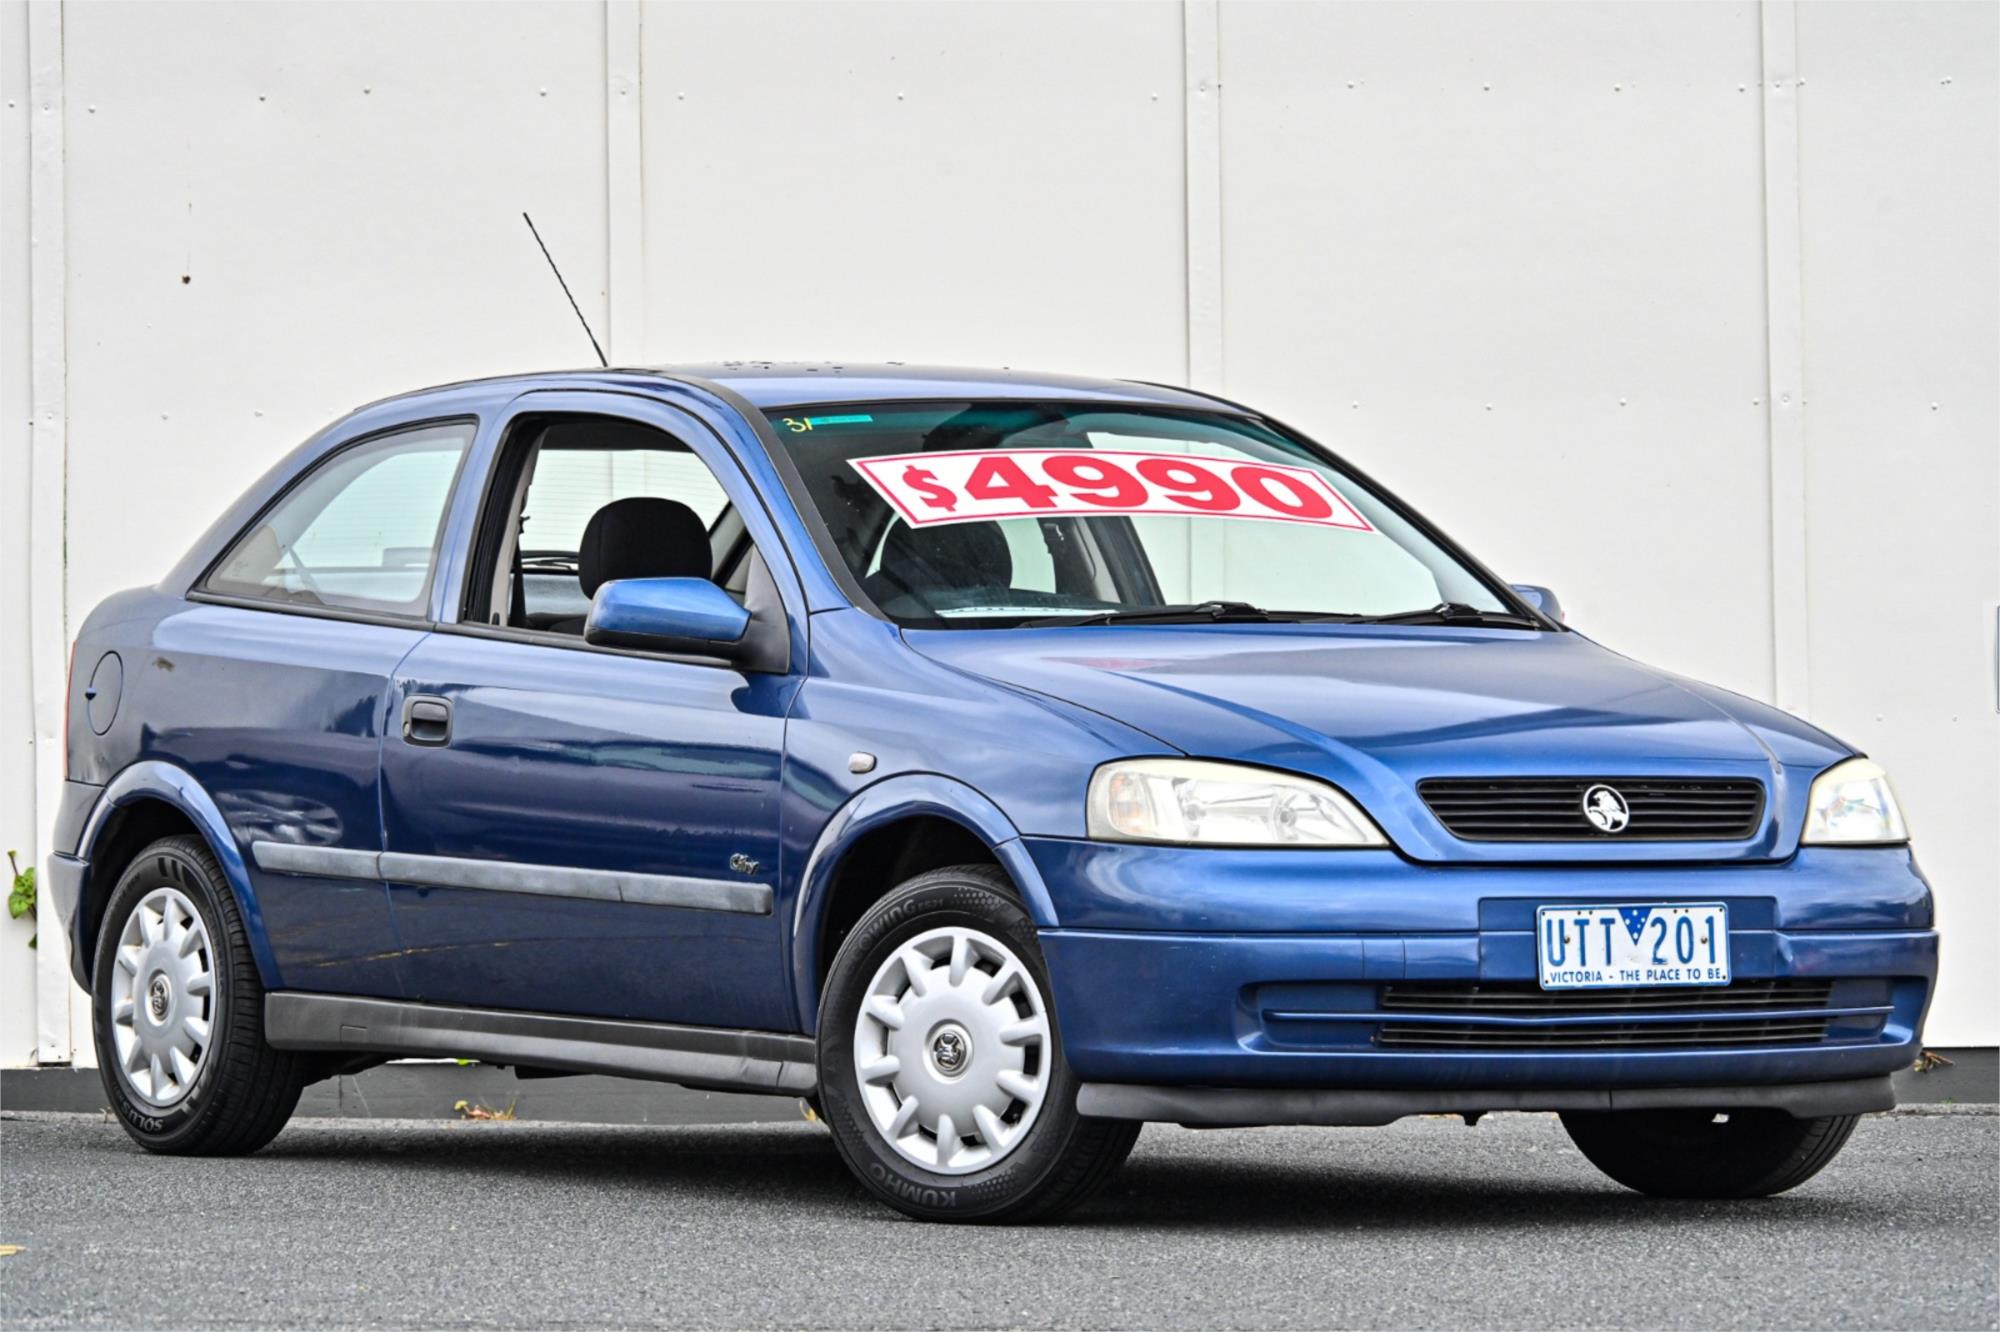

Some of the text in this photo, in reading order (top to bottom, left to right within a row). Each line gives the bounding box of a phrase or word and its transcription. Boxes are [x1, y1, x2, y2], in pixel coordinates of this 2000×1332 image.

[782, 417, 813, 432] 31
[902, 454, 1334, 519] $4990
[1546, 915, 1715, 967] UTT 201
[1550, 970, 1603, 983] VICTORIA
[1620, 970, 1640, 982] THE
[1647, 968, 1681, 981] PLACE
[1687, 968, 1701, 980] TO
[1707, 967, 1721, 980] BE
[120, 1100, 164, 1131] SOLUS
[868, 1162, 956, 1207] KUMHO
